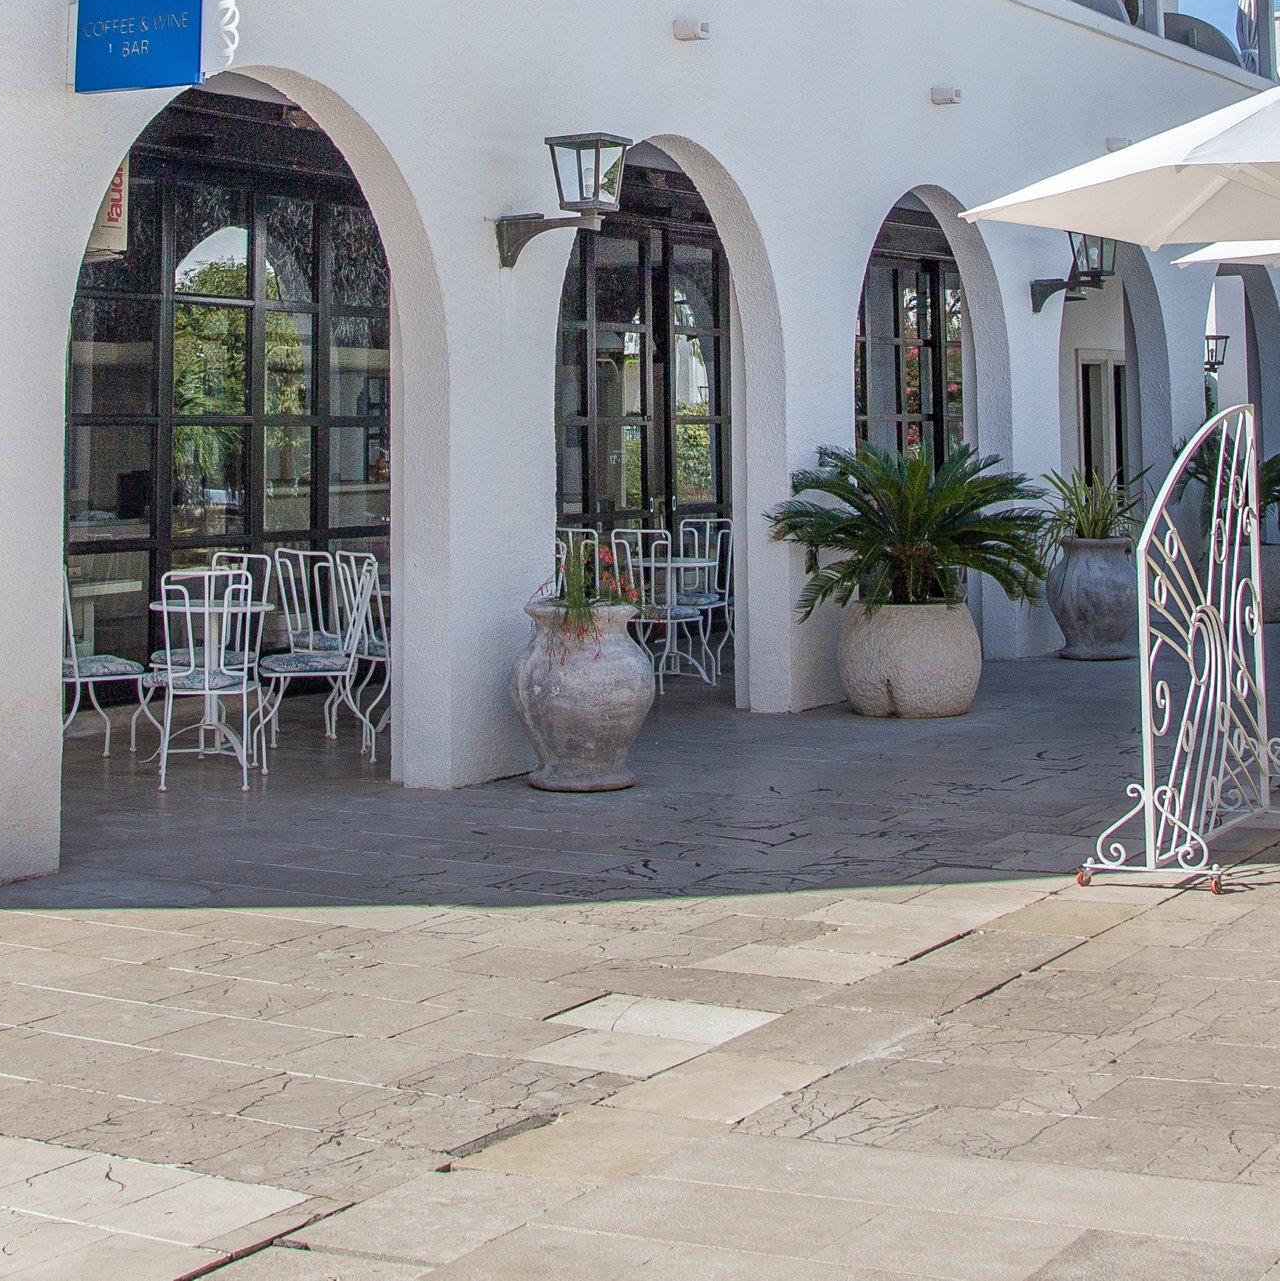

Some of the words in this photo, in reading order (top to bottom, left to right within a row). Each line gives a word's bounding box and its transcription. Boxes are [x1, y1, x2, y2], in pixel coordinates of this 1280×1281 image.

[83, 17, 135, 38] COFFEE
[139, 15, 149, 32] &
[152, 11, 188, 30] WINE
[122, 39, 149, 58] BAR
